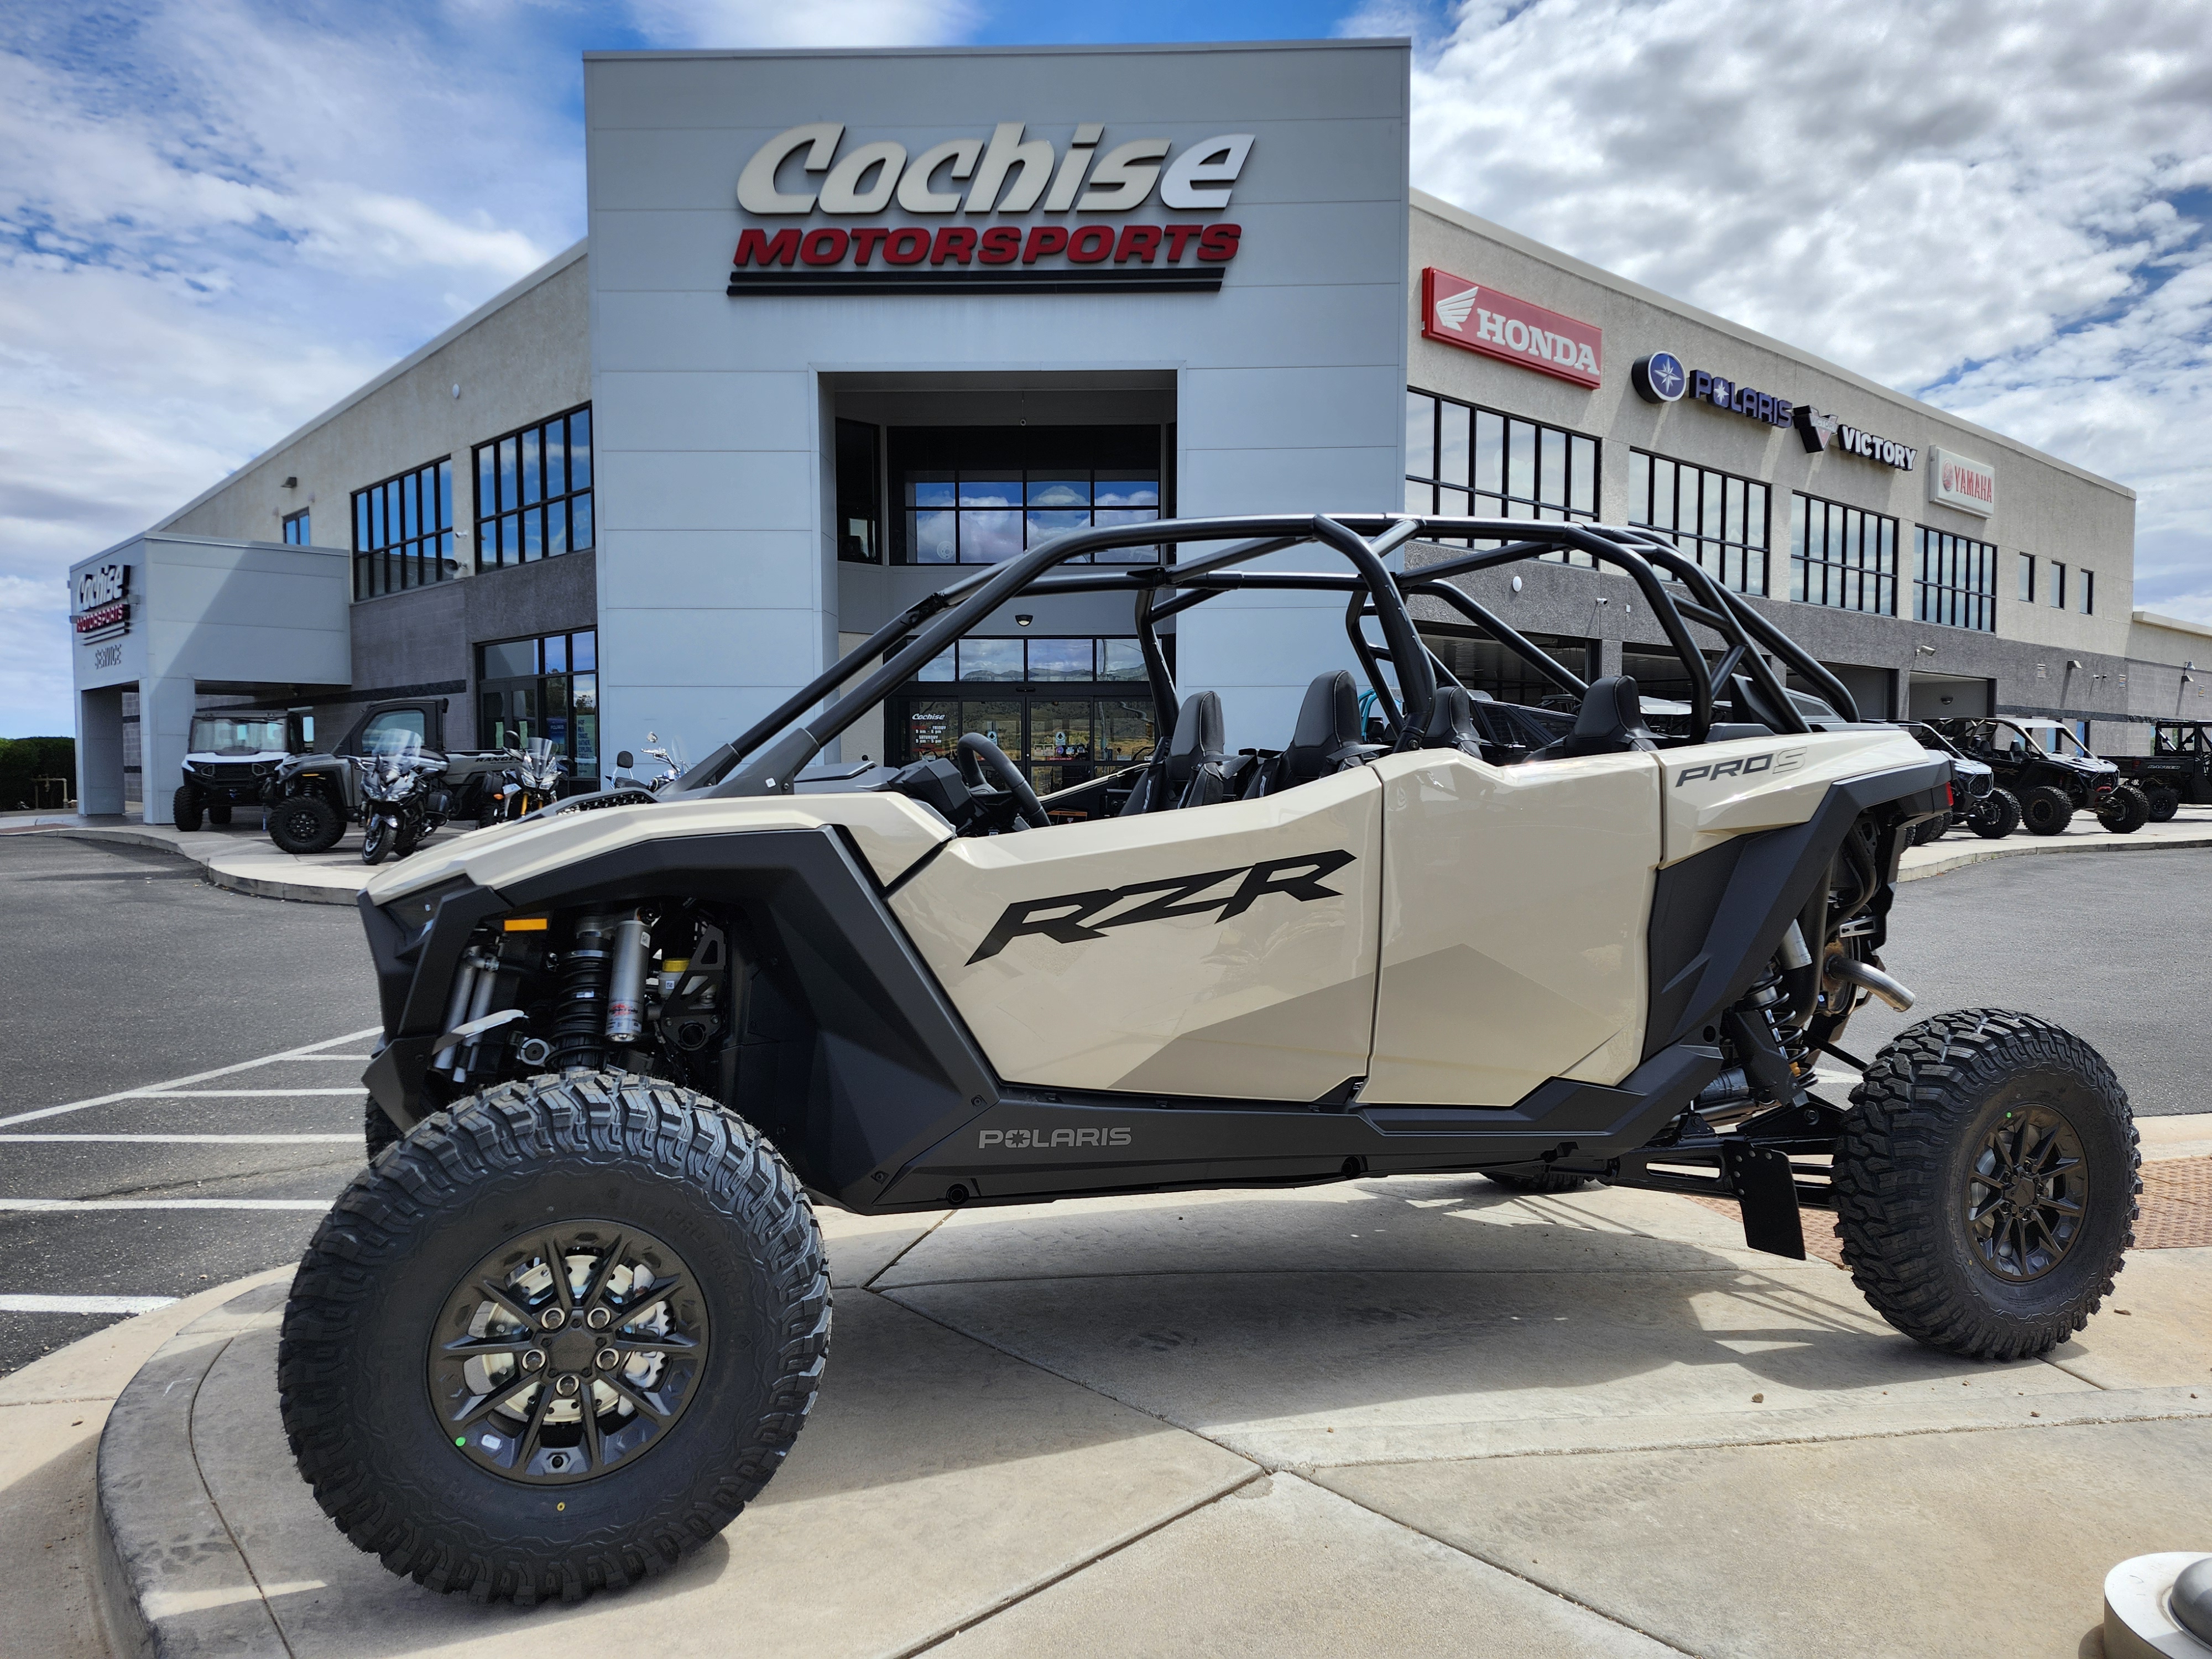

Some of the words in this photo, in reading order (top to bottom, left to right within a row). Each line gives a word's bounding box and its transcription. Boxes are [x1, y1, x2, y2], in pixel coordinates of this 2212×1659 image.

[737, 122, 1255, 213] Cochise
[733, 223, 1242, 267] MOTORSPORTS
[1477, 307, 1600, 375] HONDA
[1690, 369, 1793, 429] POLARIS
[1810, 416, 1837, 431] VICTORY
[1838, 424, 1918, 471] VICTORY
[1954, 465, 1992, 503] YAMAHA
[76, 565, 128, 612] Cochise
[76, 604, 126, 633] MOTORSPORTS
[95, 644, 122, 670] SERVICE
[1675, 753, 1773, 788] PRO
[964, 849, 1358, 967] RZR
[979, 1127, 1132, 1149] POLARIS
